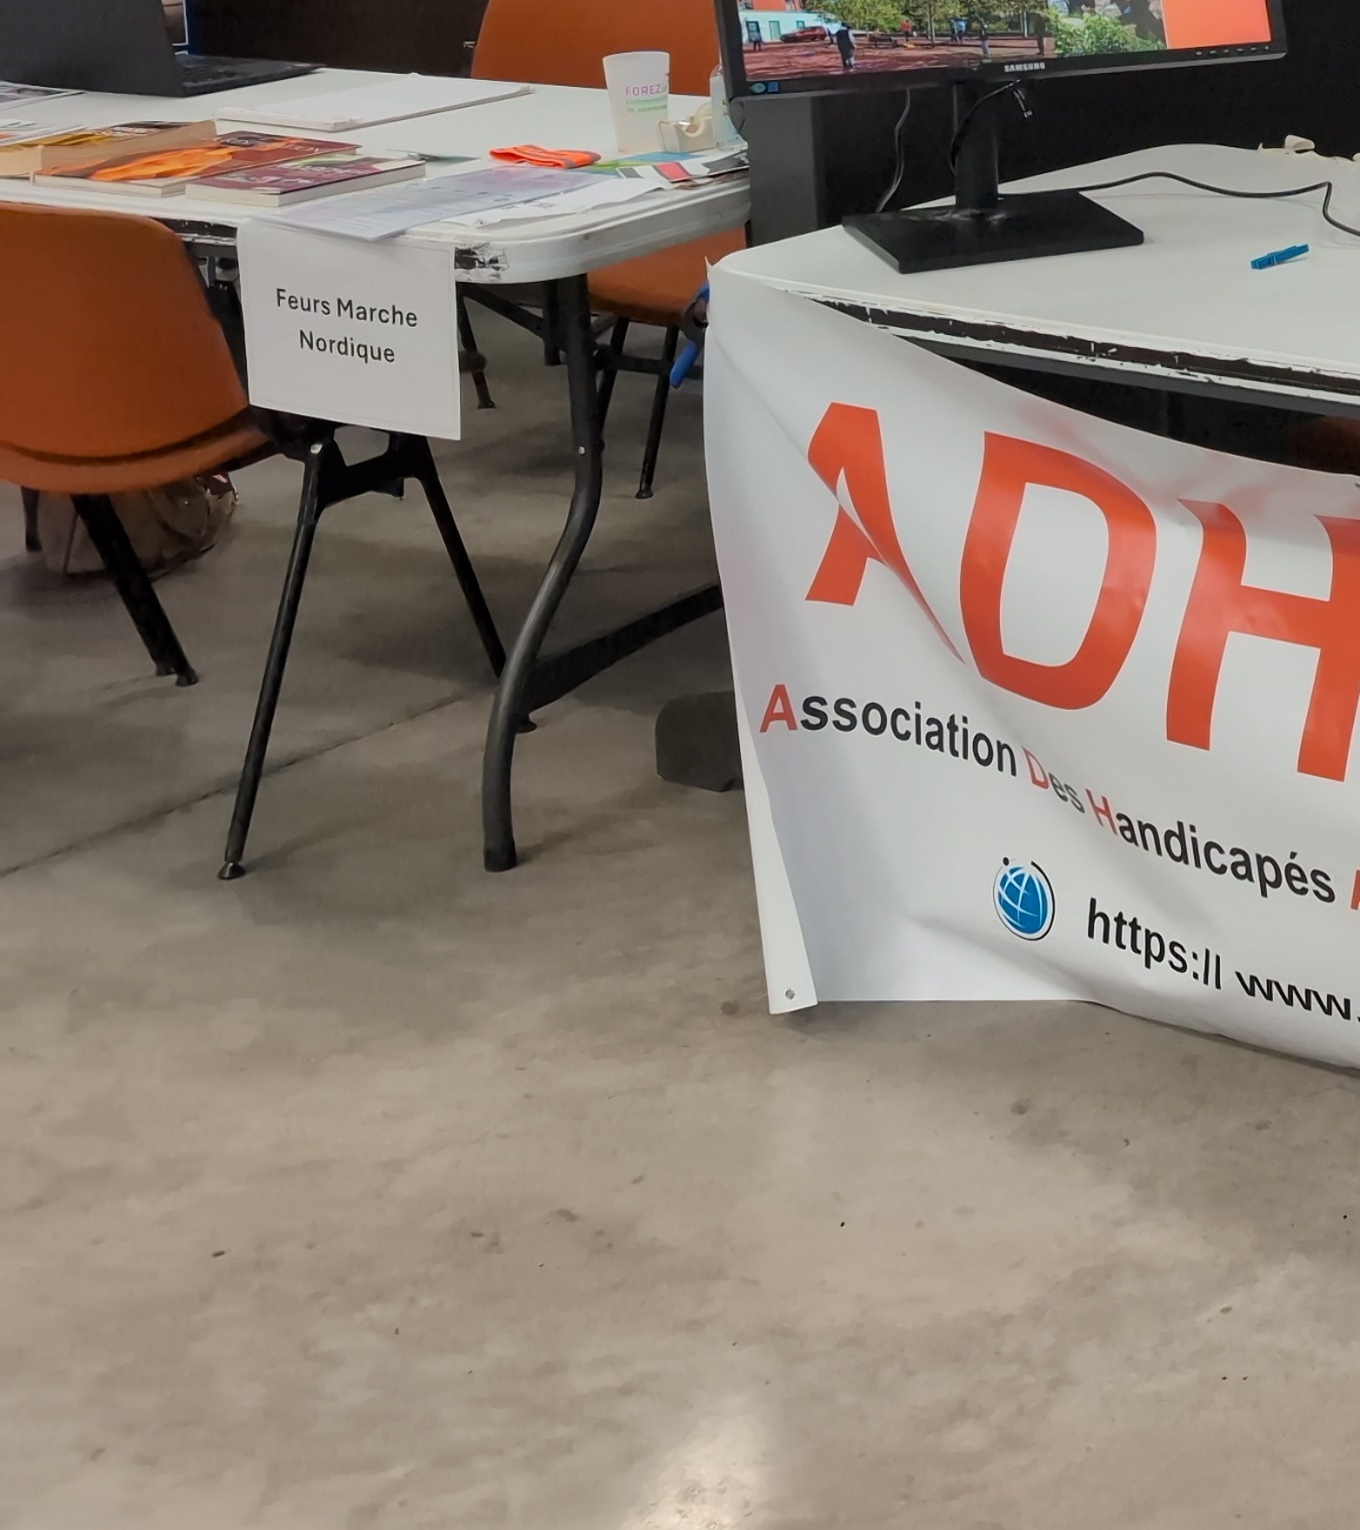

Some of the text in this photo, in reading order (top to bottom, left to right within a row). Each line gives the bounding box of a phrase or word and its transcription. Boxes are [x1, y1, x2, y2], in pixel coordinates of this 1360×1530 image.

[1004, 61, 1047, 73] SAMSUNG
[276, 288, 419, 329] Feurs Marche
[298, 329, 396, 364] Nordique
[758, 682, 1019, 778] Association
[1023, 745, 1087, 815] Des
[1087, 786, 1335, 903] Handicapés
